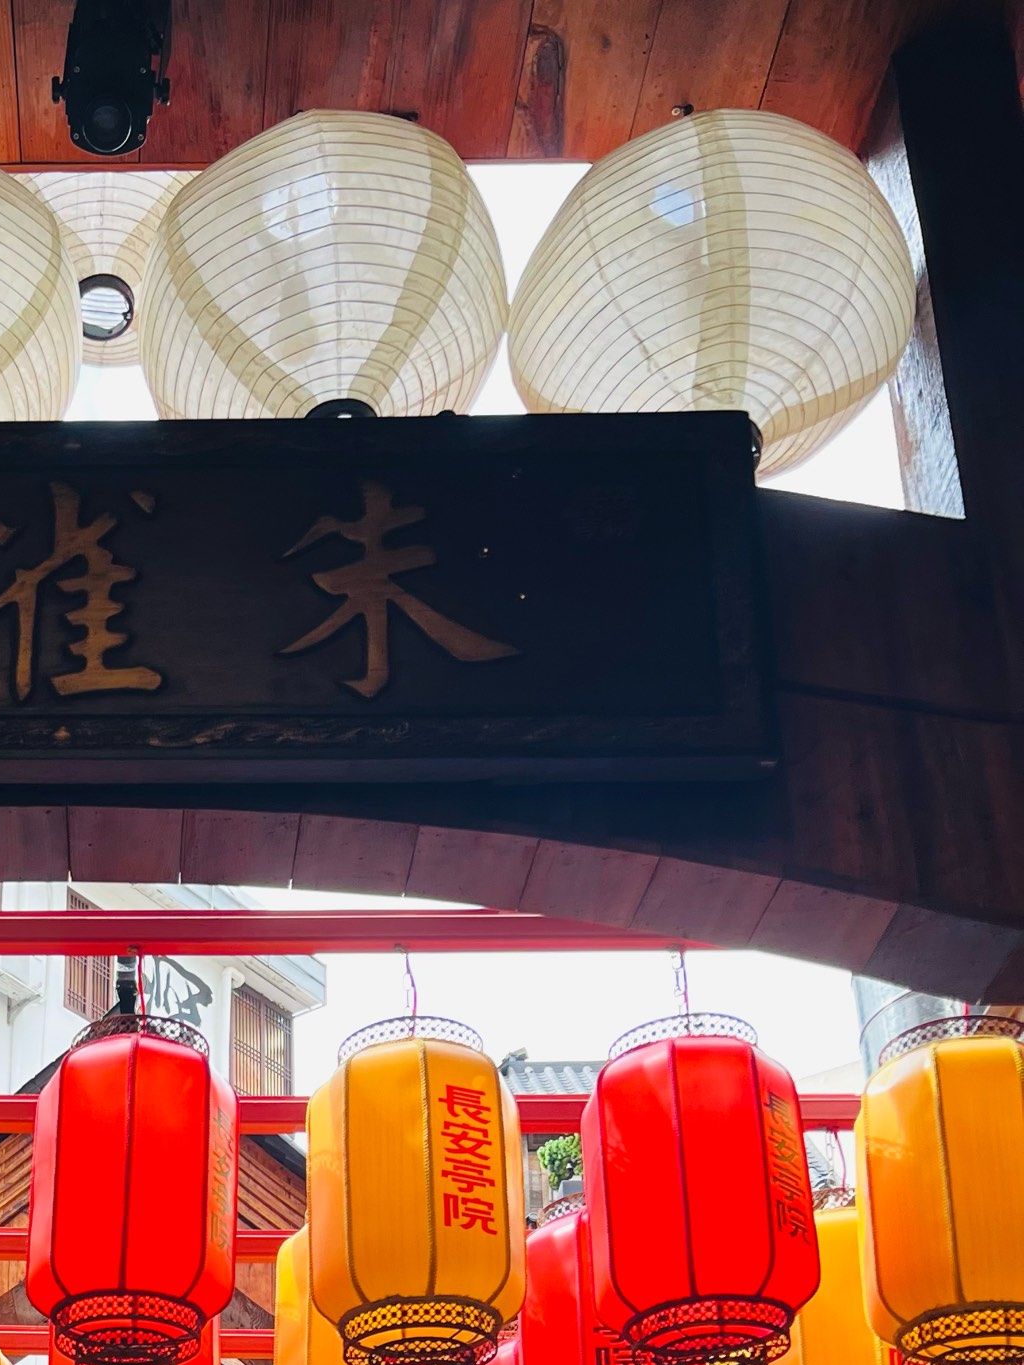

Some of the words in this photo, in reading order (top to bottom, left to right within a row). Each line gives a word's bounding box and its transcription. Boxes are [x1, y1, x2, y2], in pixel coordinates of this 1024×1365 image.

[438, 1084, 497, 1235] 長安亭院
[764, 1091, 810, 1245] 長安亭院
